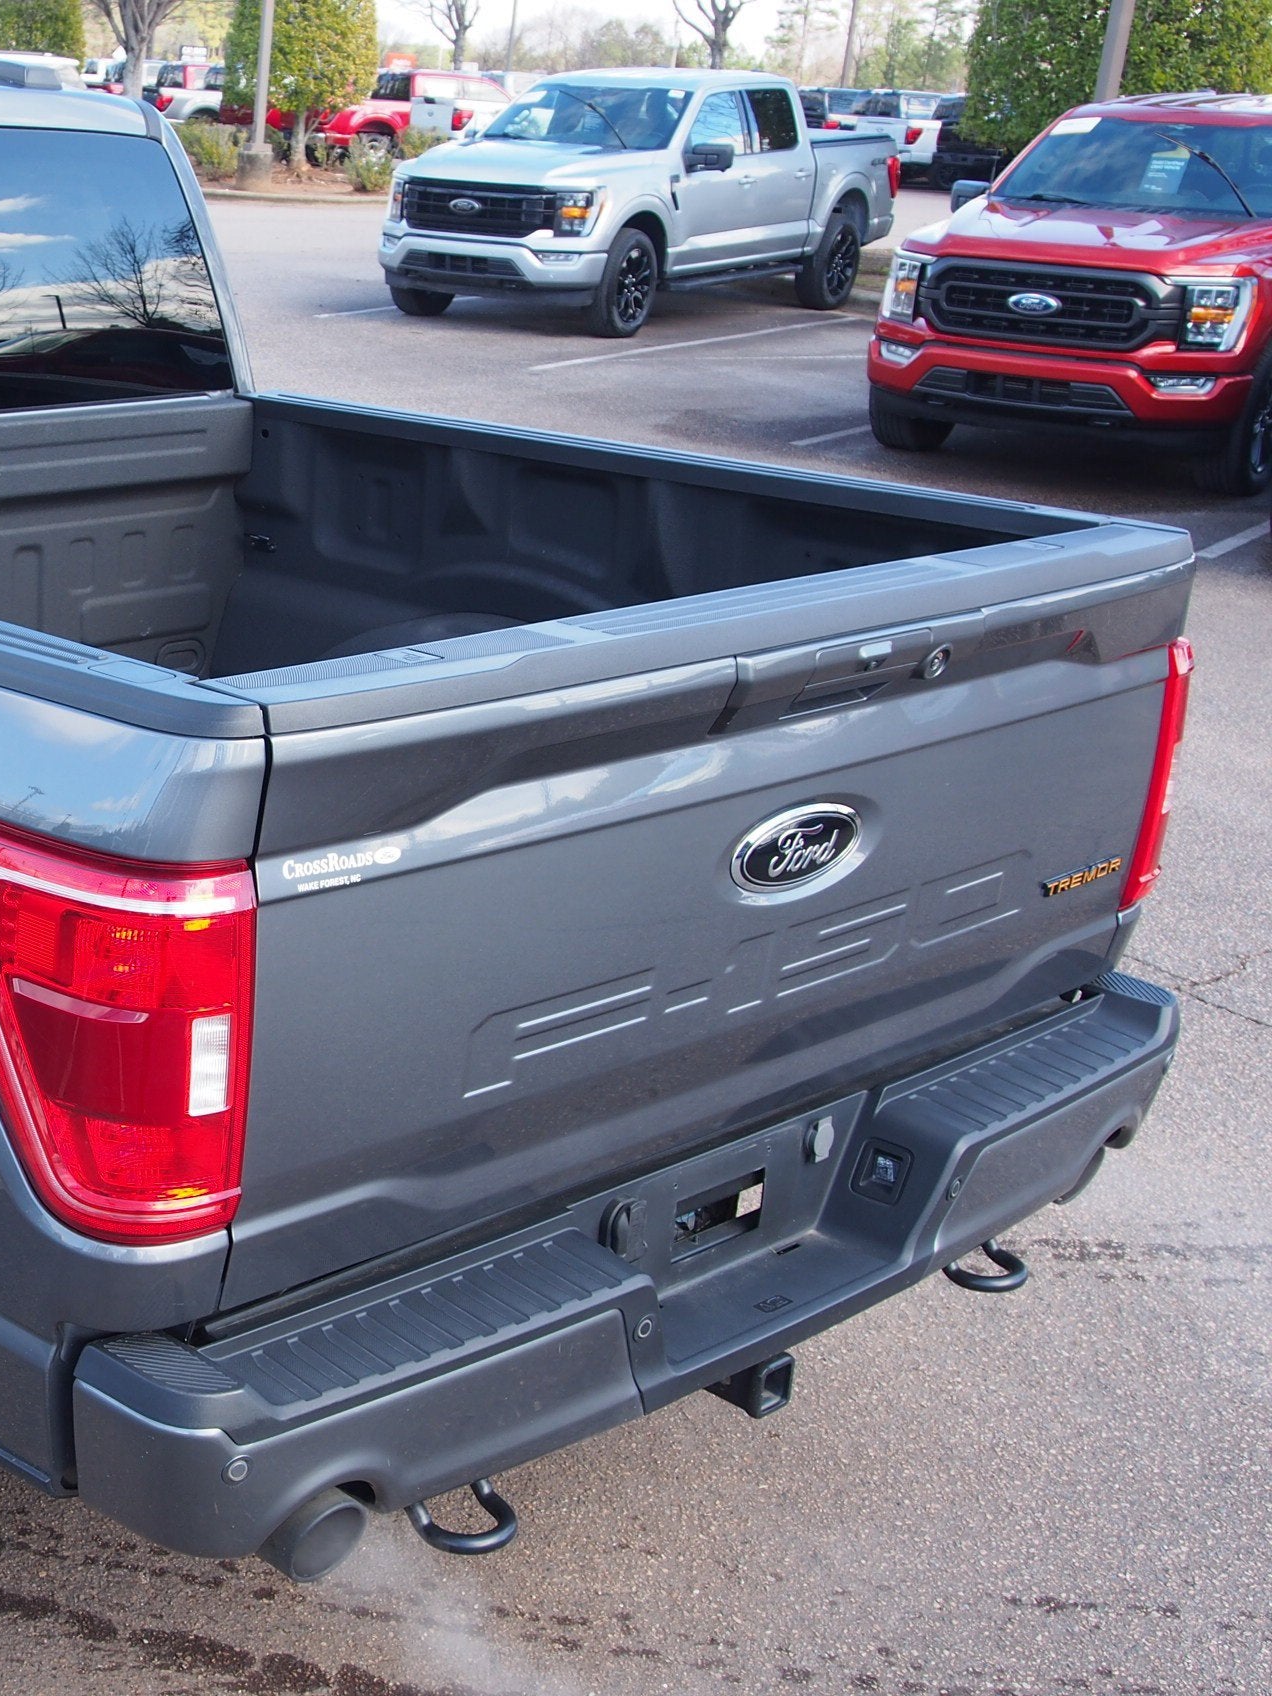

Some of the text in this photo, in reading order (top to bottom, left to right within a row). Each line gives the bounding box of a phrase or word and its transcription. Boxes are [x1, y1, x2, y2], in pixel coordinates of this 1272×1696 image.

[1019, 297, 1046, 310] Ford
[768, 823, 839, 878] Ford
[297, 881, 320, 892] WAKE
[350, 873, 362, 884] NC
[1047, 857, 1123, 896] TREMOR
[463, 849, 1030, 1099] F-150
